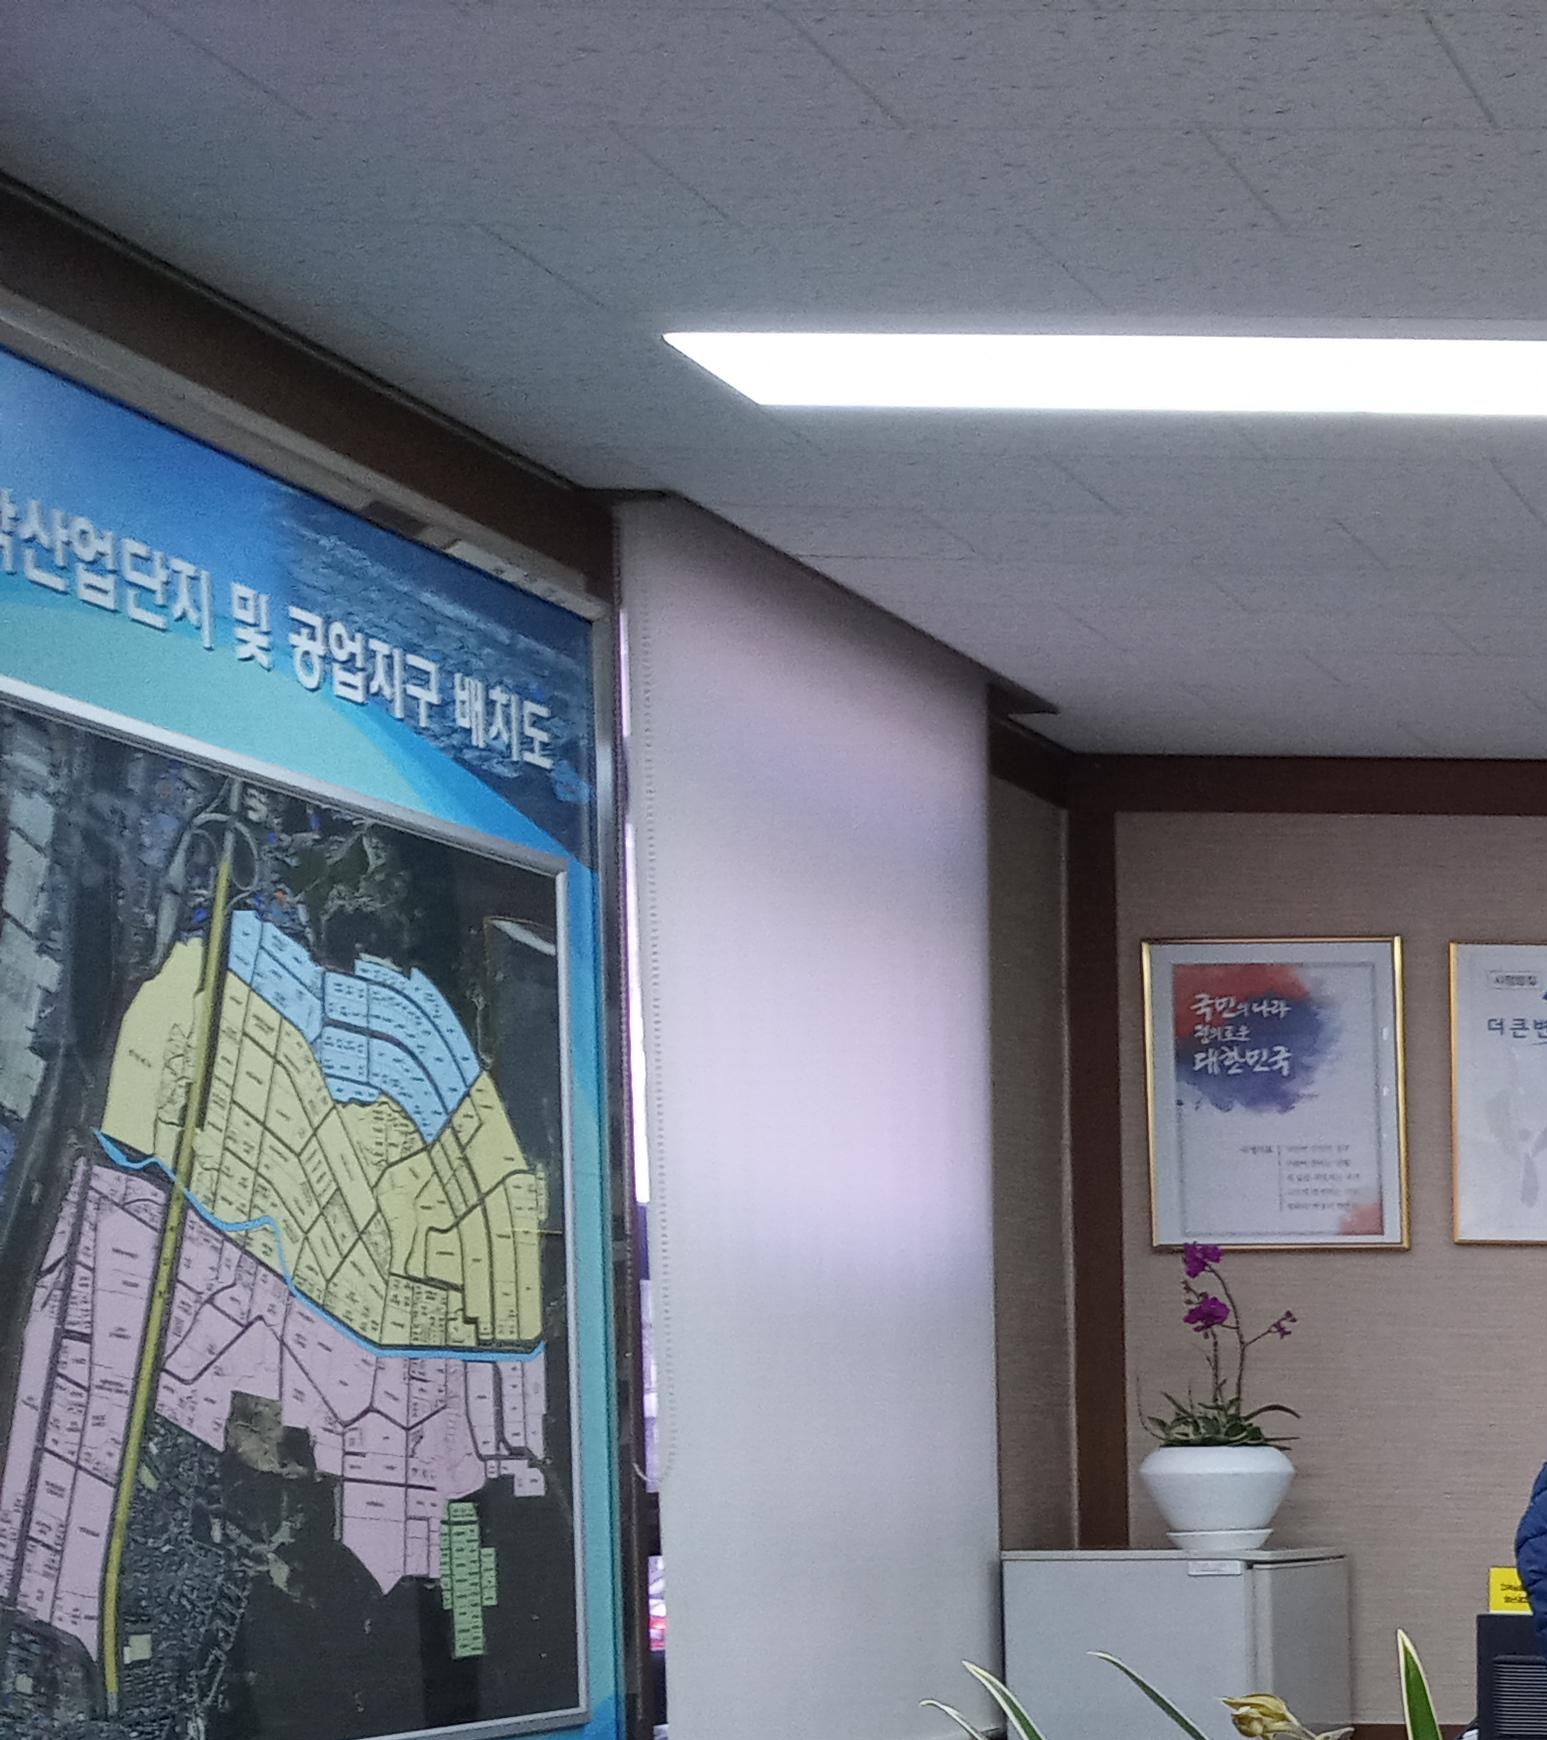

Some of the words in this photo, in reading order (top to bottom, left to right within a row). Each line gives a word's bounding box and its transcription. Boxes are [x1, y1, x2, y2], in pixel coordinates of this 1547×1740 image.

[0, 488, 213, 648] 산업단지
[231, 582, 272, 670] 및
[288, 605, 441, 728] 공업지구
[453, 671, 554, 771] 배치도
[1250, 999, 1293, 1019] 나라
[1487, 1018, 1505, 1036] 더
[1509, 1018, 1530, 1039] 큰
[1192, 1045, 1293, 1077] 대한민국
